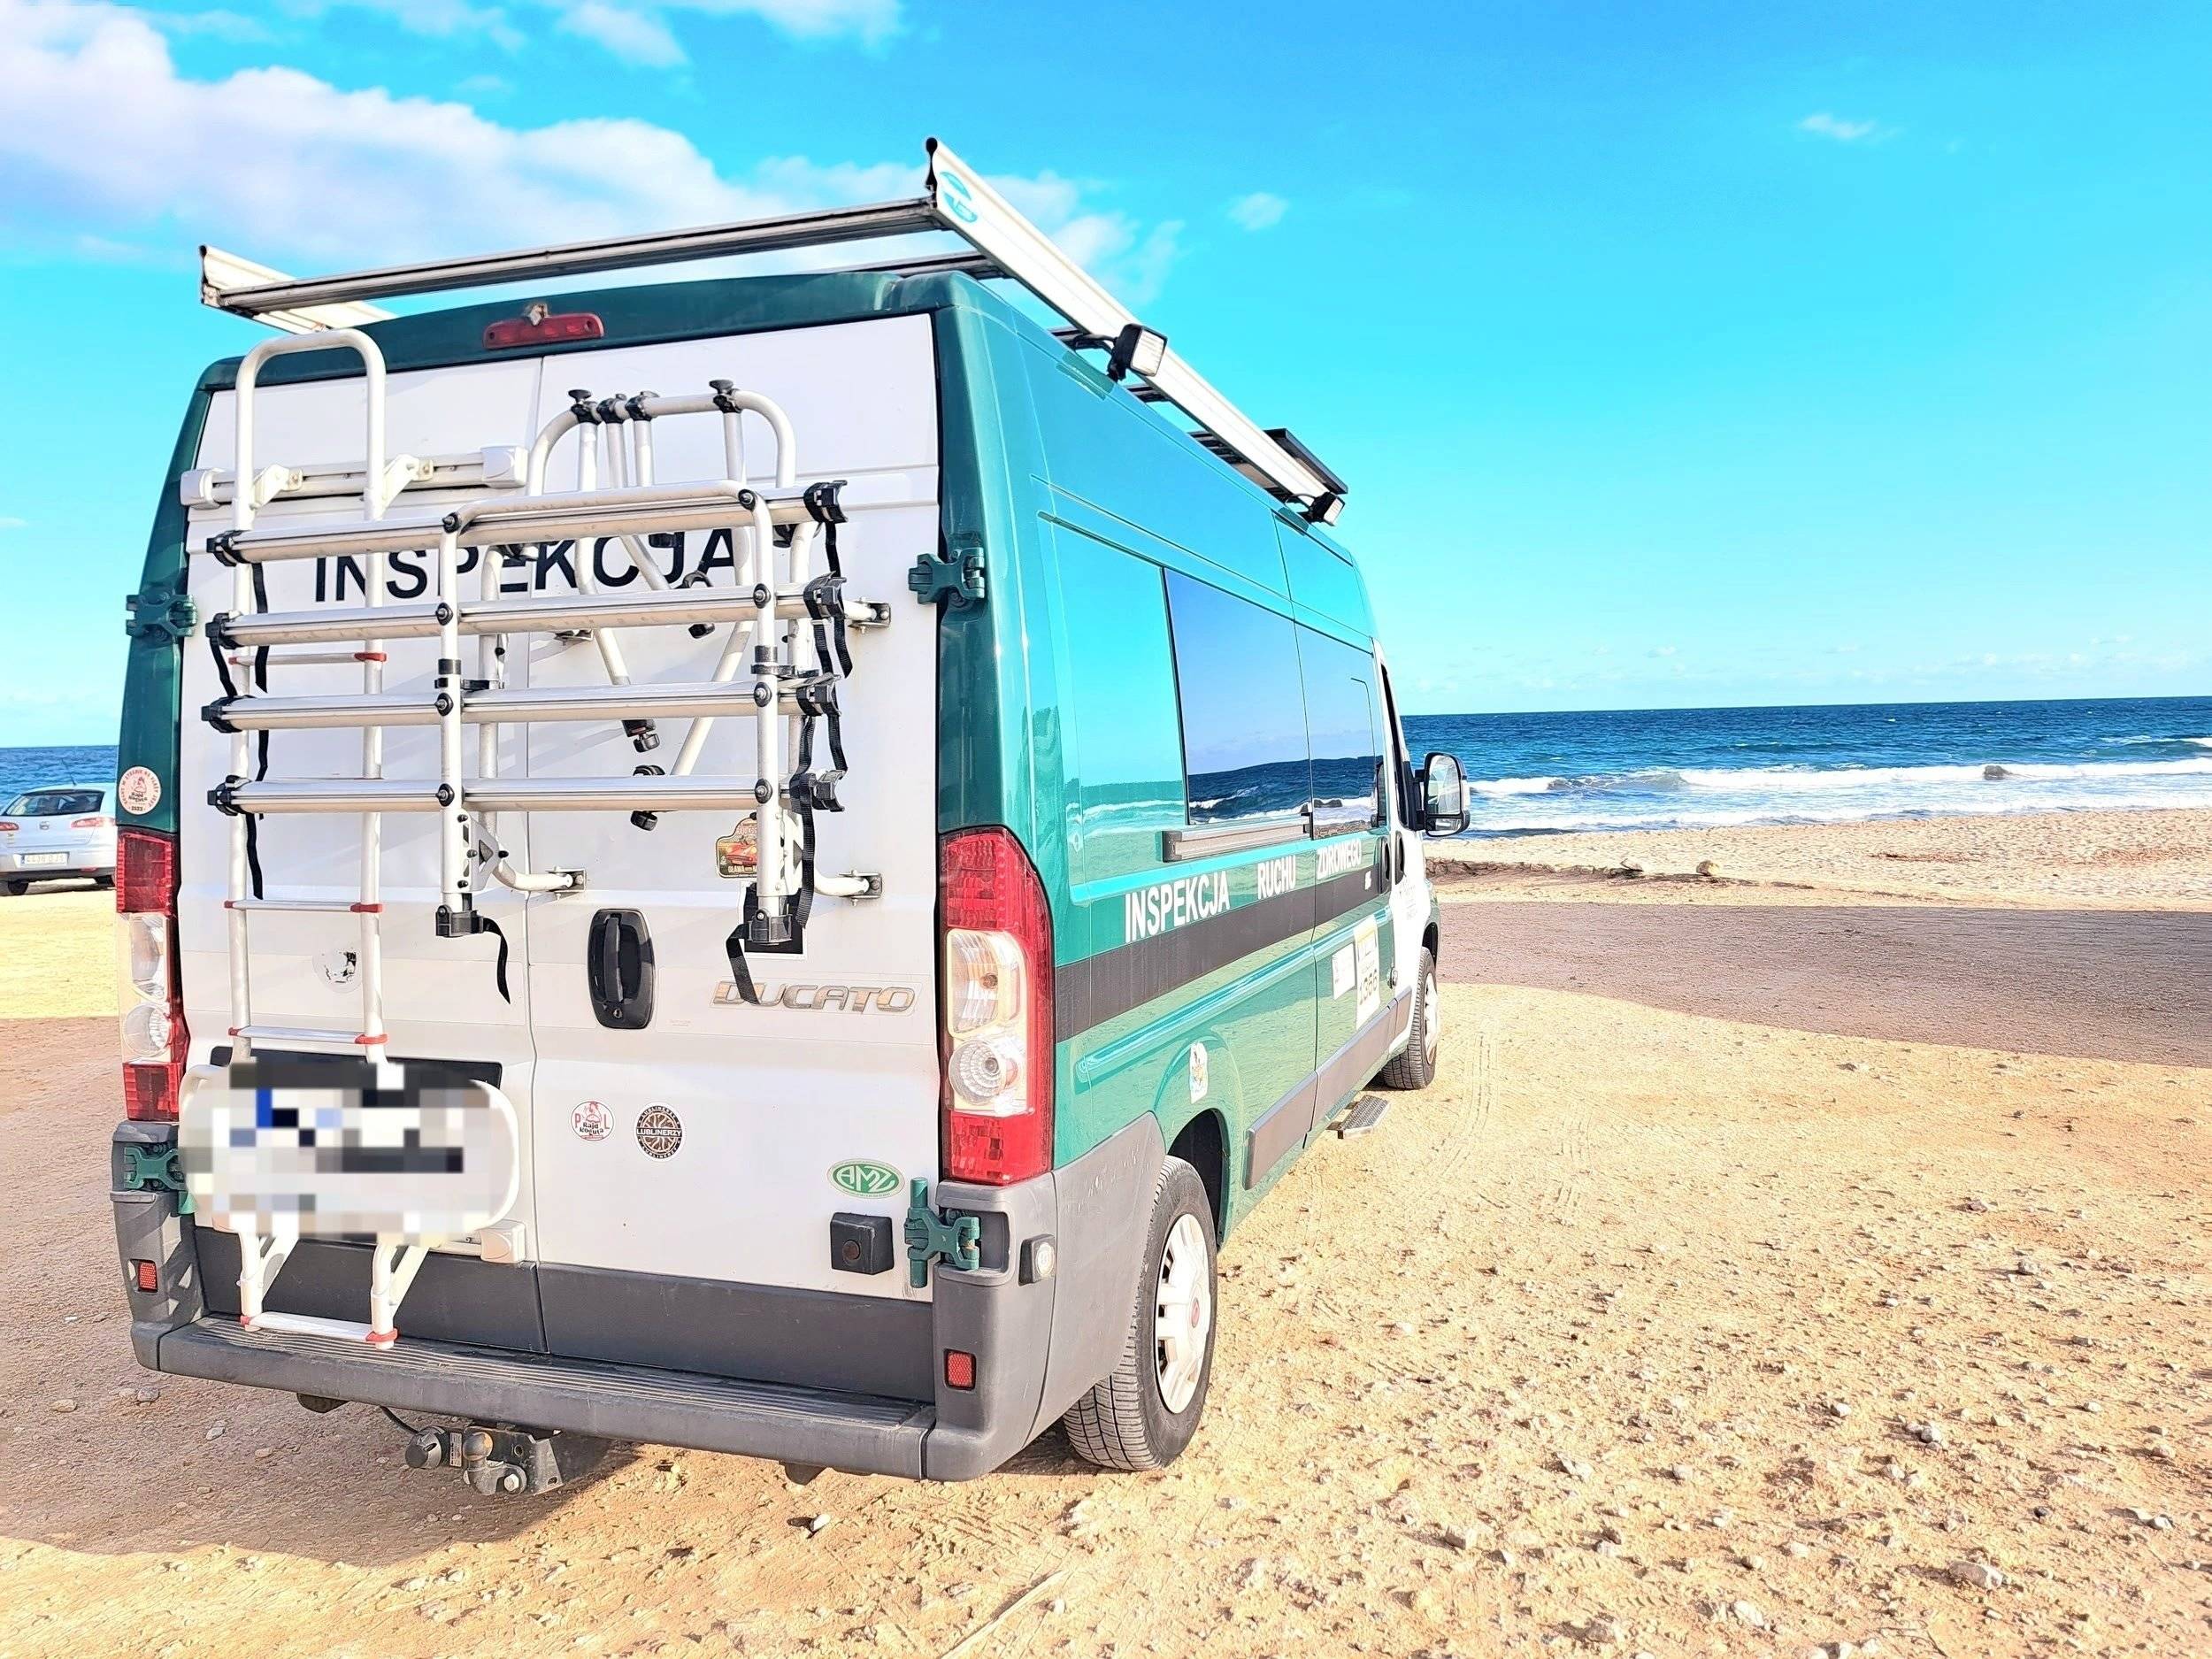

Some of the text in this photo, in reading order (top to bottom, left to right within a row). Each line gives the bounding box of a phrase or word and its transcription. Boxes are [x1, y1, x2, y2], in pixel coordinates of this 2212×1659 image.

[1125, 871, 1231, 944] INSPEKCJA
[1257, 855, 1296, 900] RUCHU
[713, 980, 916, 1013] DUCATO
[636, 1128, 682, 1137] LUBLINERZY
